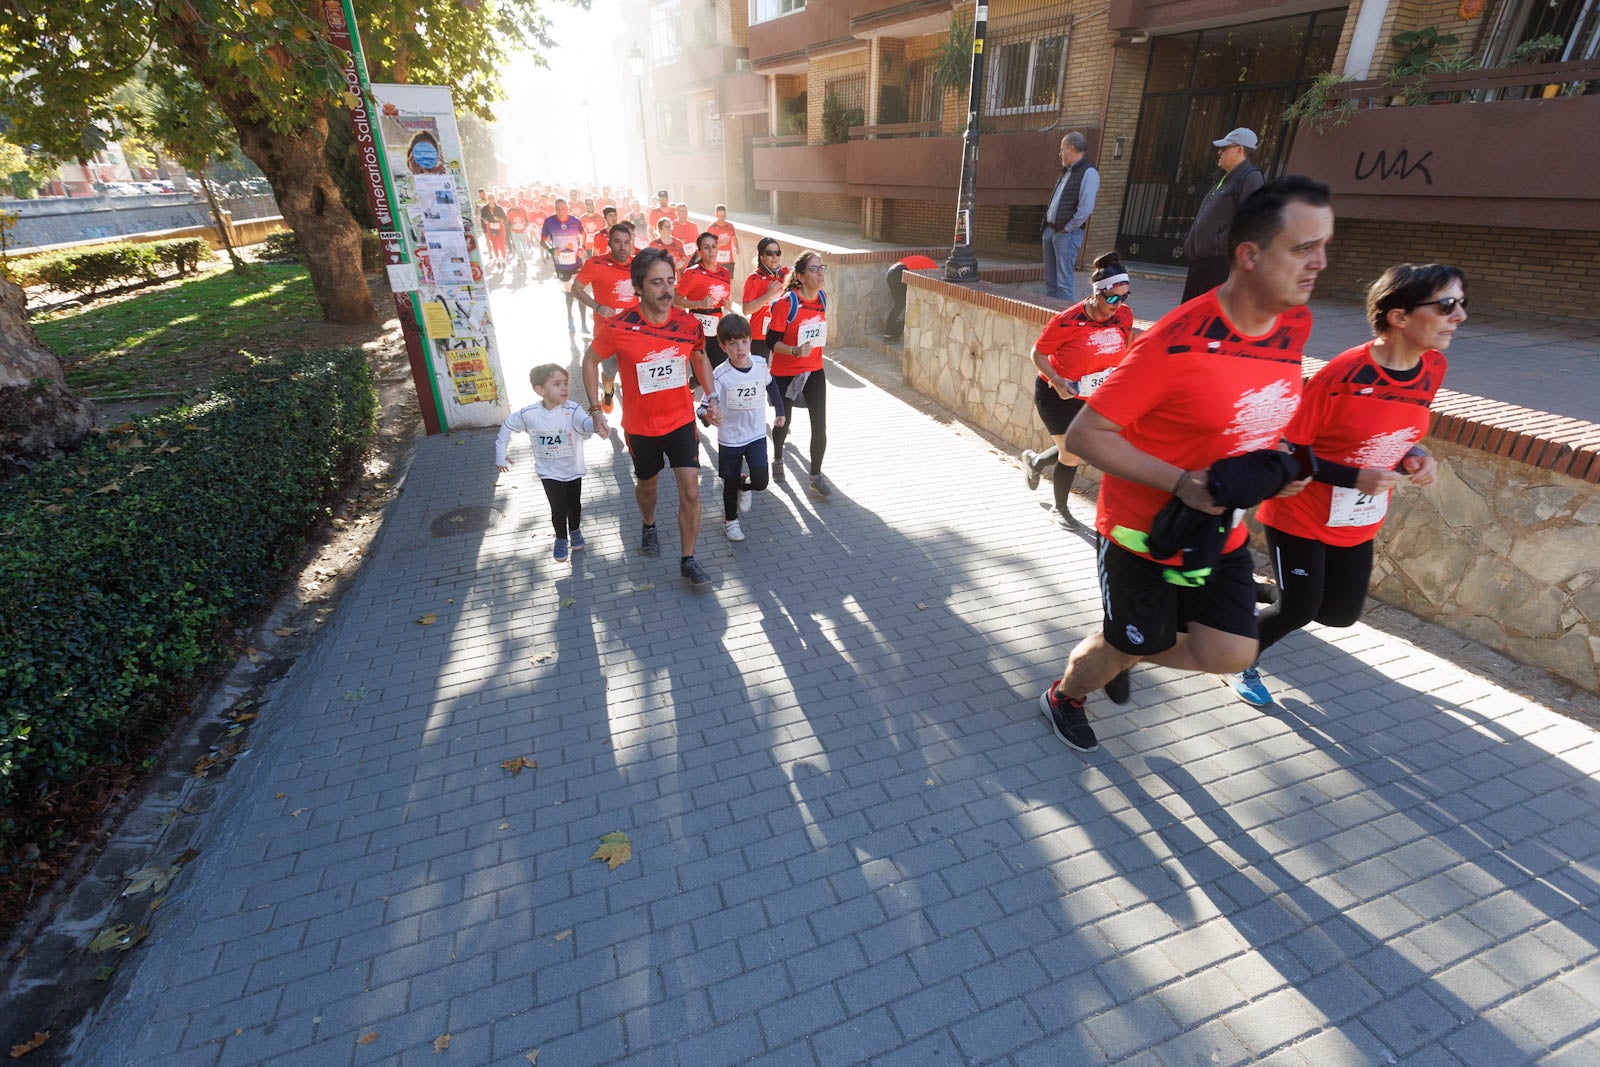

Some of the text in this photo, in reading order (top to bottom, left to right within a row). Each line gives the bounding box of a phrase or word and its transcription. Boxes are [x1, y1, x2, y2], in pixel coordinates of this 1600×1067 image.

[1239, 66, 1247, 81] 2
[805, 328, 820, 339] 722
[648, 364, 673, 378] 725
[737, 386, 757, 397] 723
[539, 435, 562, 445] 724
